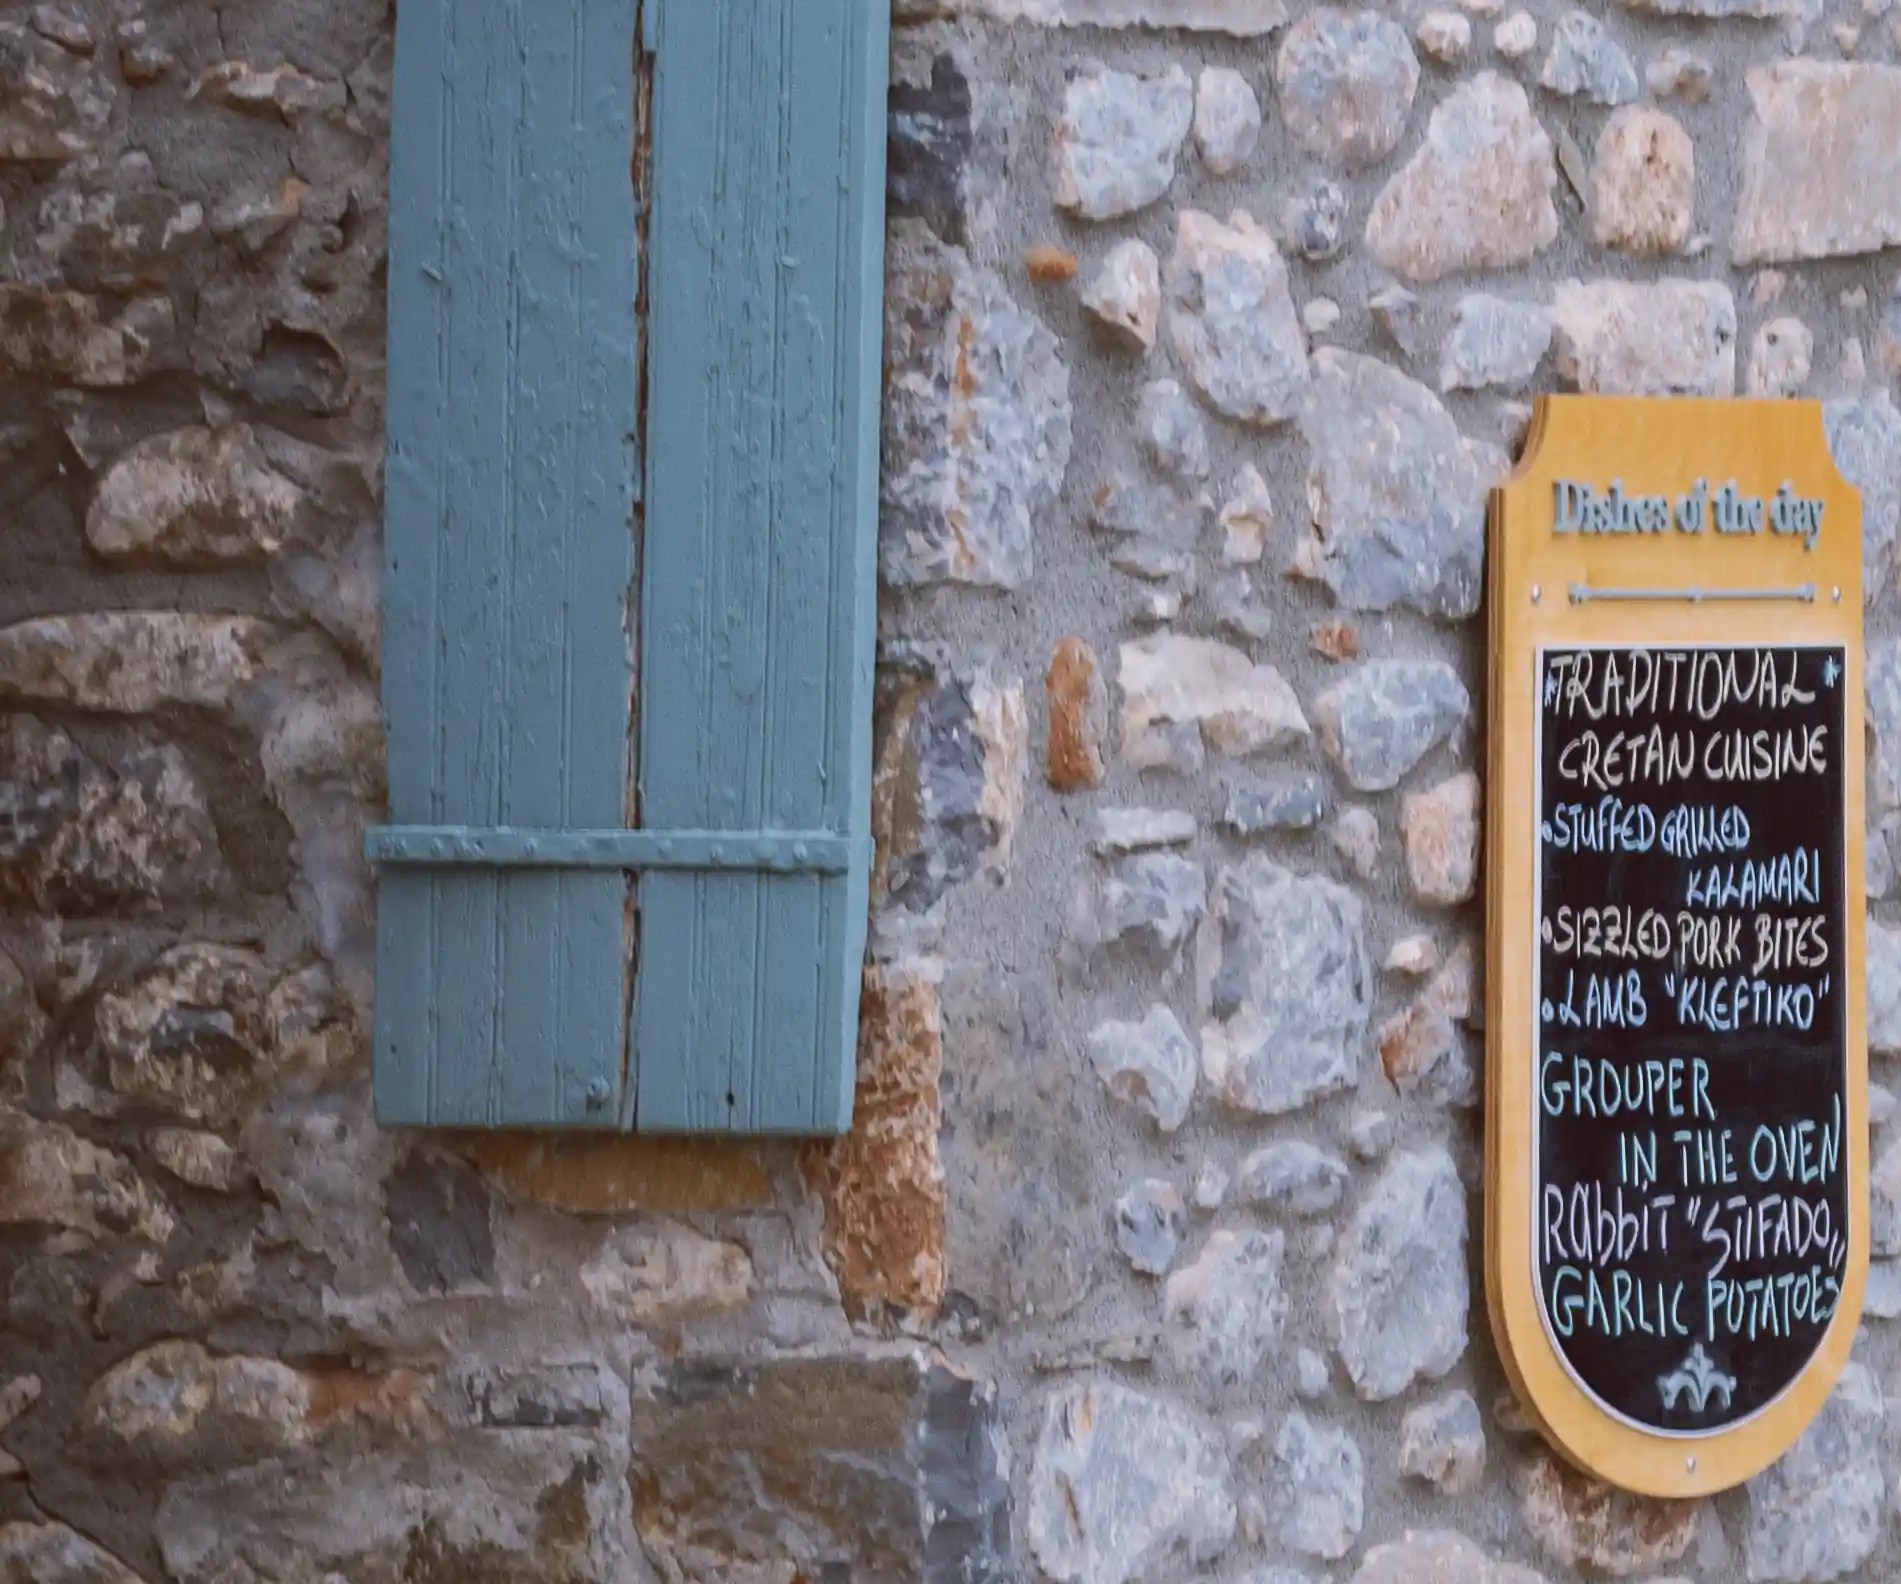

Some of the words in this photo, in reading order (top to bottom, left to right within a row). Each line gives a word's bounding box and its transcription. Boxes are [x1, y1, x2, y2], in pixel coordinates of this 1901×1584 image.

[1553, 477, 1669, 536] Dishes
[1674, 476, 1709, 535] of
[1711, 477, 1764, 535] the
[1769, 478, 1823, 552] day
[1551, 647, 1816, 720] TRADITIONAL
[1559, 724, 1695, 792] CRETAN
[1704, 724, 1828, 782] CUISINE
[1553, 794, 1655, 854] STUFFED
[1660, 803, 1750, 858] GRILLED
[1687, 846, 1820, 911] KALAMARI
[1553, 904, 1671, 960] SIZZLED
[1677, 910, 1742, 969] PORK
[1752, 913, 1829, 977] BITES
[1559, 968, 1648, 1029] LAMB
[1664, 971, 1830, 1032] "KLEFTIKO"
[1541, 1051, 1716, 1120] GROUPER
[1620, 1130, 1657, 1187] IN
[1673, 1128, 1738, 1187] THE
[1751, 1092, 1841, 1184] OVEN
[1552, 1265, 1688, 1337] GARLIC
[1708, 1265, 1840, 1342] POTATOES
